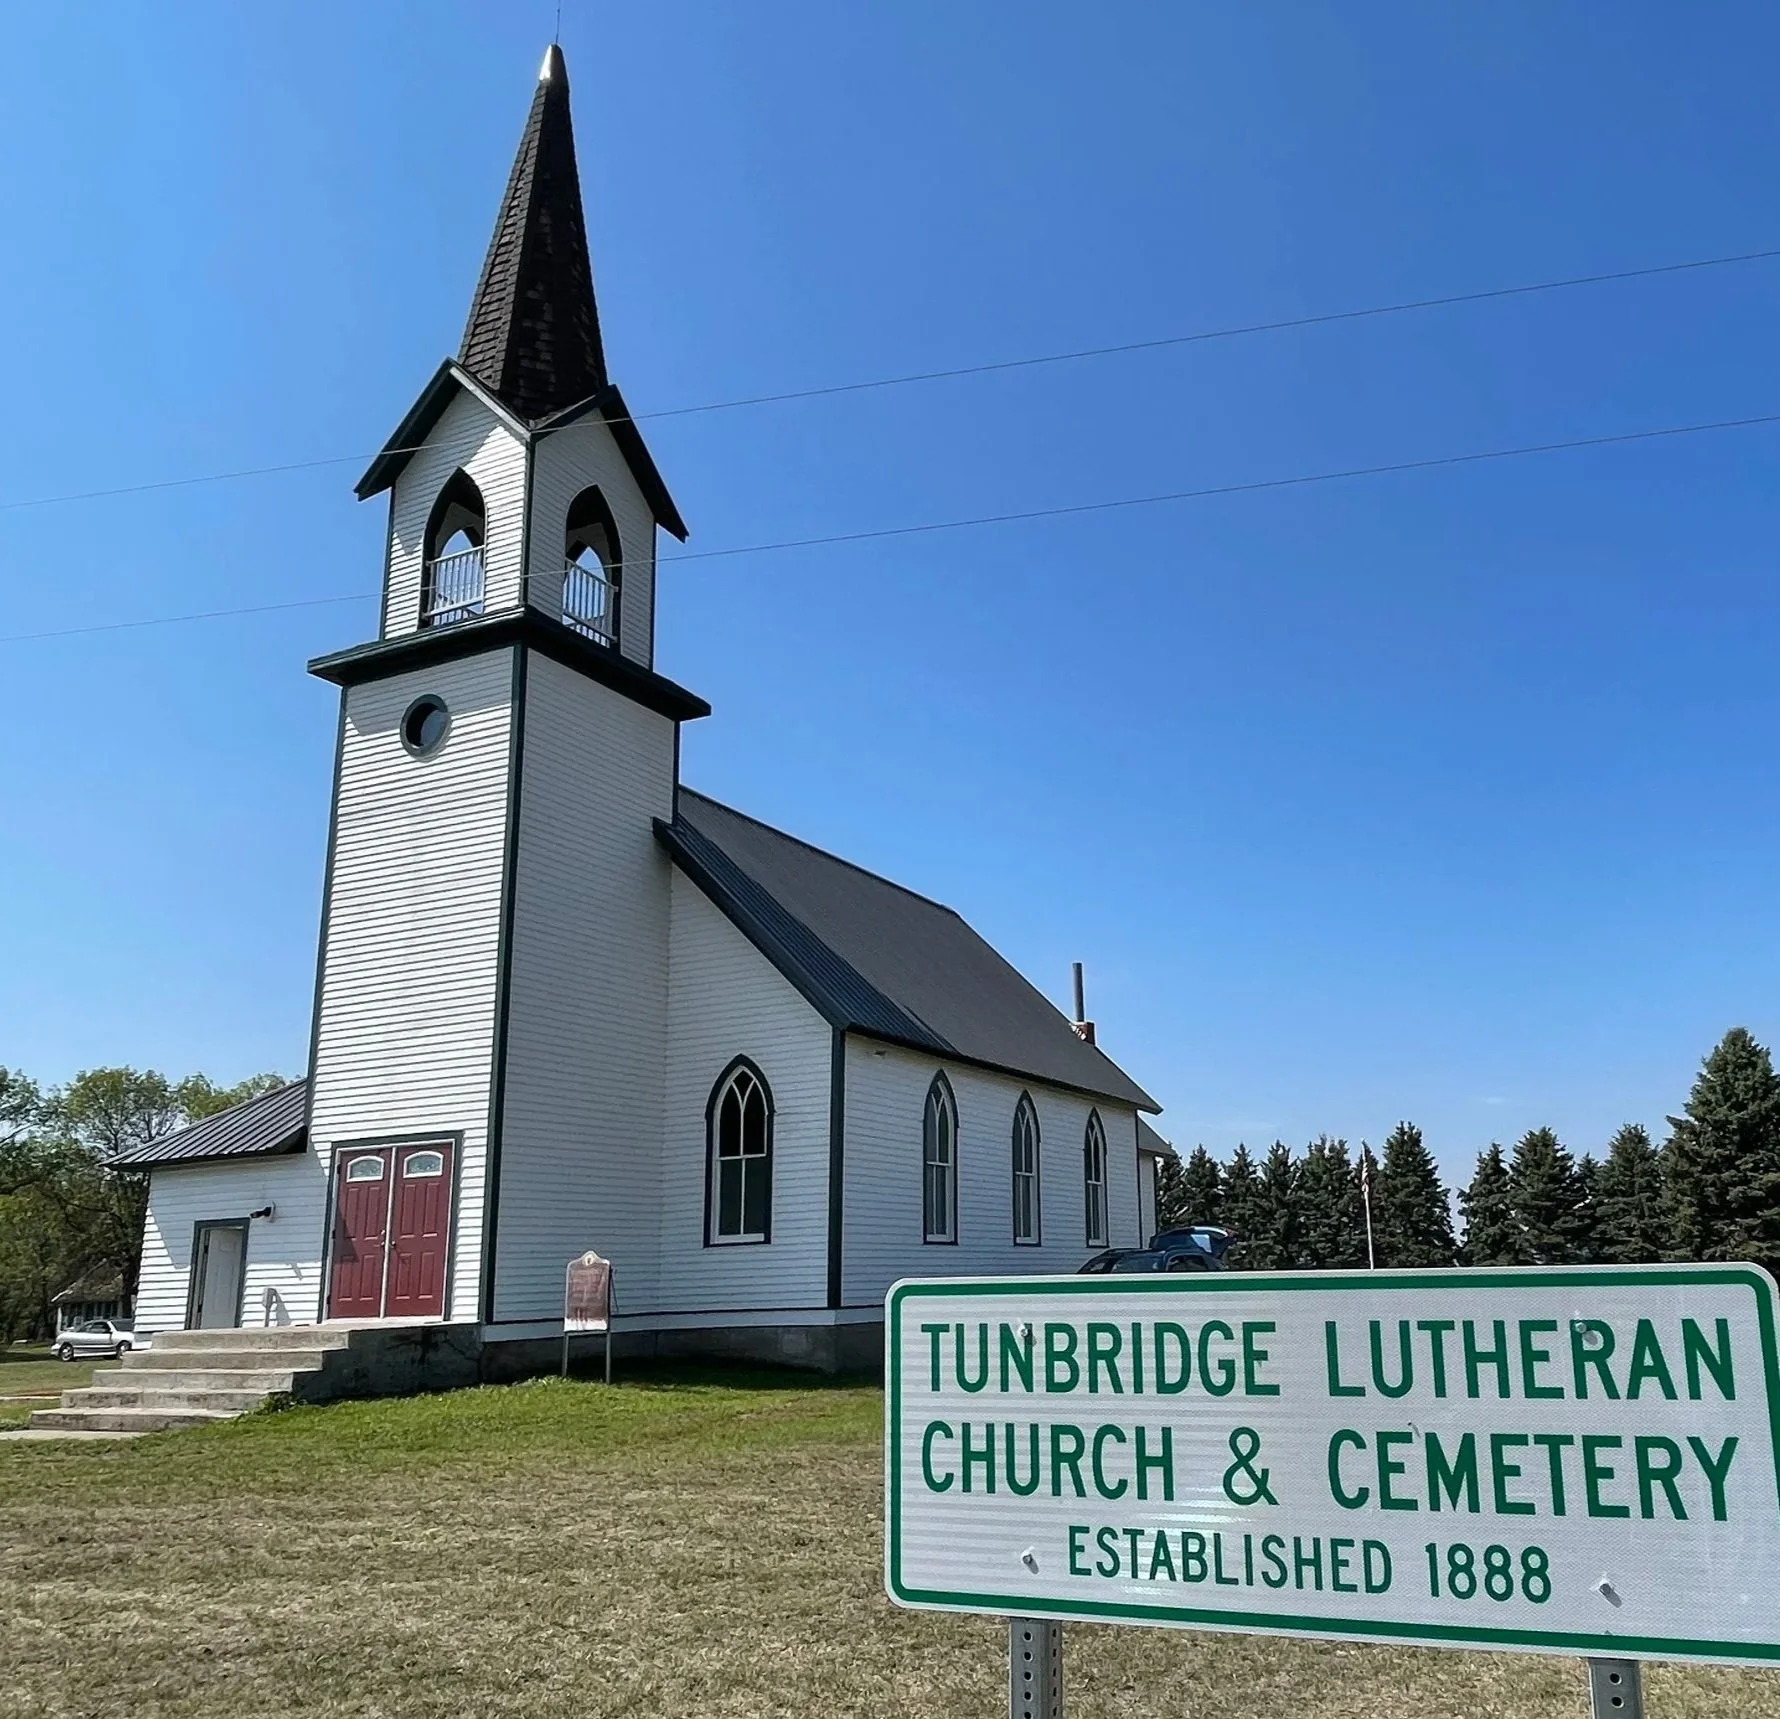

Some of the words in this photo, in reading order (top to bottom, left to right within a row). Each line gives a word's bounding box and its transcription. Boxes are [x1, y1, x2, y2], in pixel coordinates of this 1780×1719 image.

[921, 1320, 1280, 1397] TUNBRIDGE
[1326, 1318, 1736, 1400] LUTHERAN
[922, 1420, 1174, 1501] CHURCH
[1223, 1428, 1276, 1505] &
[1328, 1429, 1739, 1521] CEMETERY
[1069, 1526, 1392, 1594] ESTABLISHED
[1425, 1544, 1551, 1604] 1888
